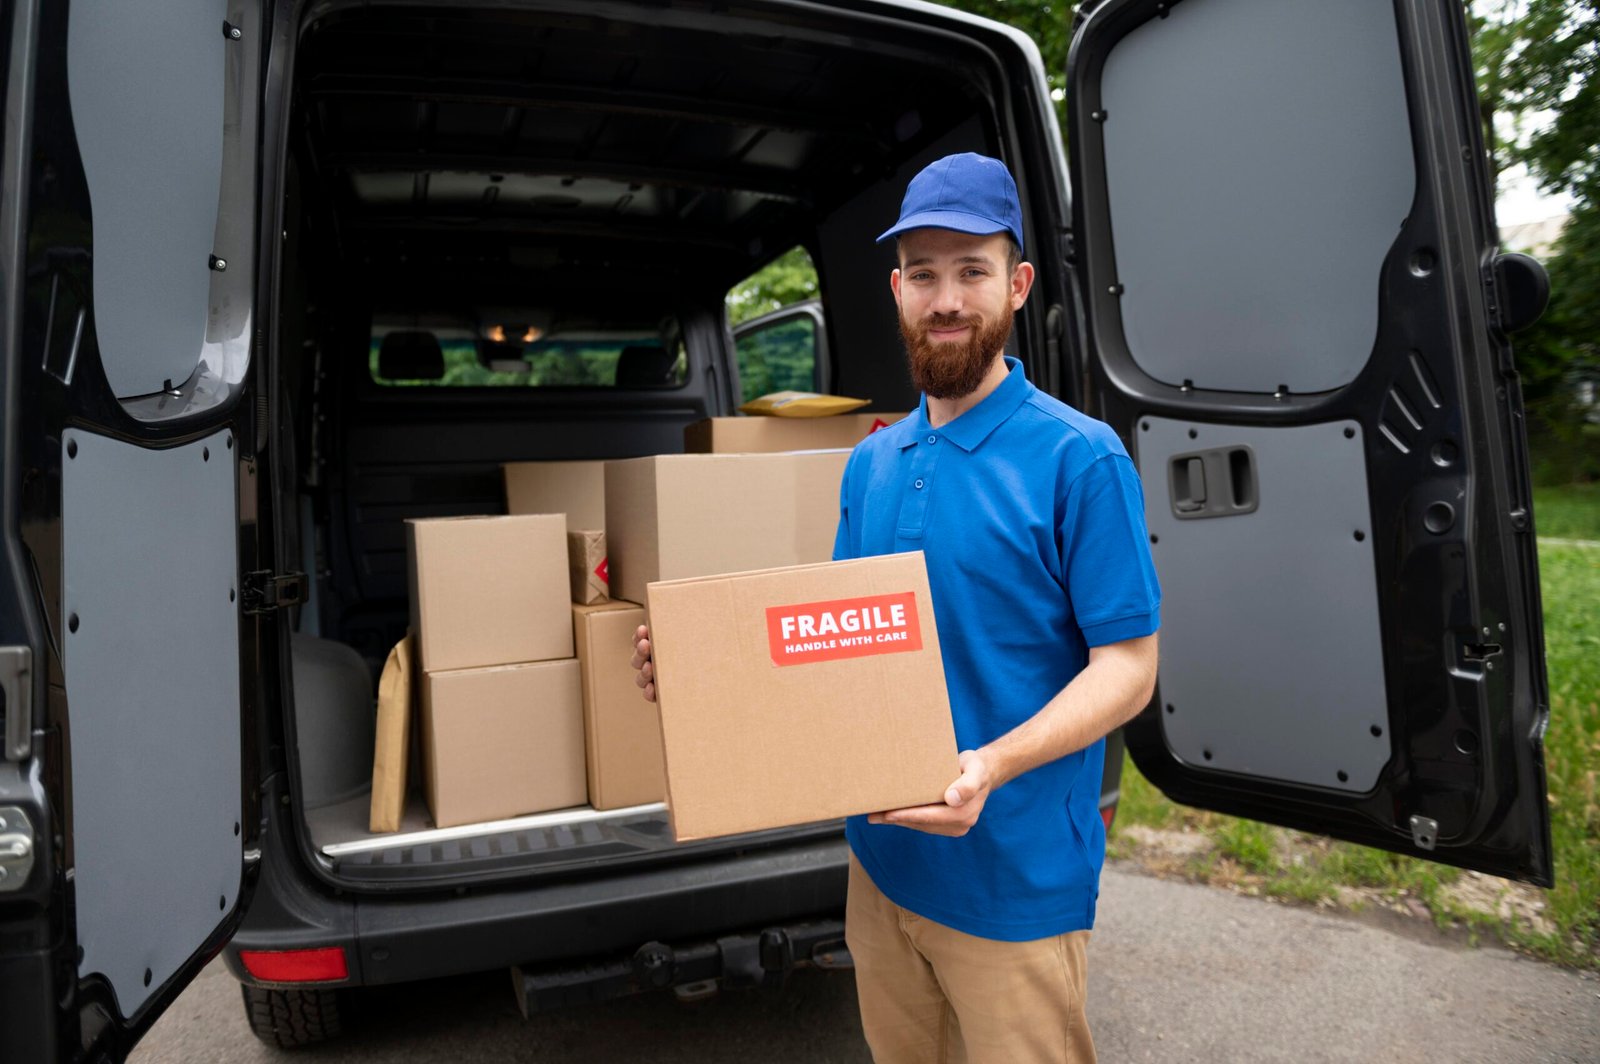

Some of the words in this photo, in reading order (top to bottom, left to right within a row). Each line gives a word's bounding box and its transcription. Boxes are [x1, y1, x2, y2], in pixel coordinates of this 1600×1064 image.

[781, 604, 906, 639] FRAGILE
[785, 640, 837, 654] HANDLE
[839, 635, 873, 647] WITH
[876, 631, 908, 643] CARE
